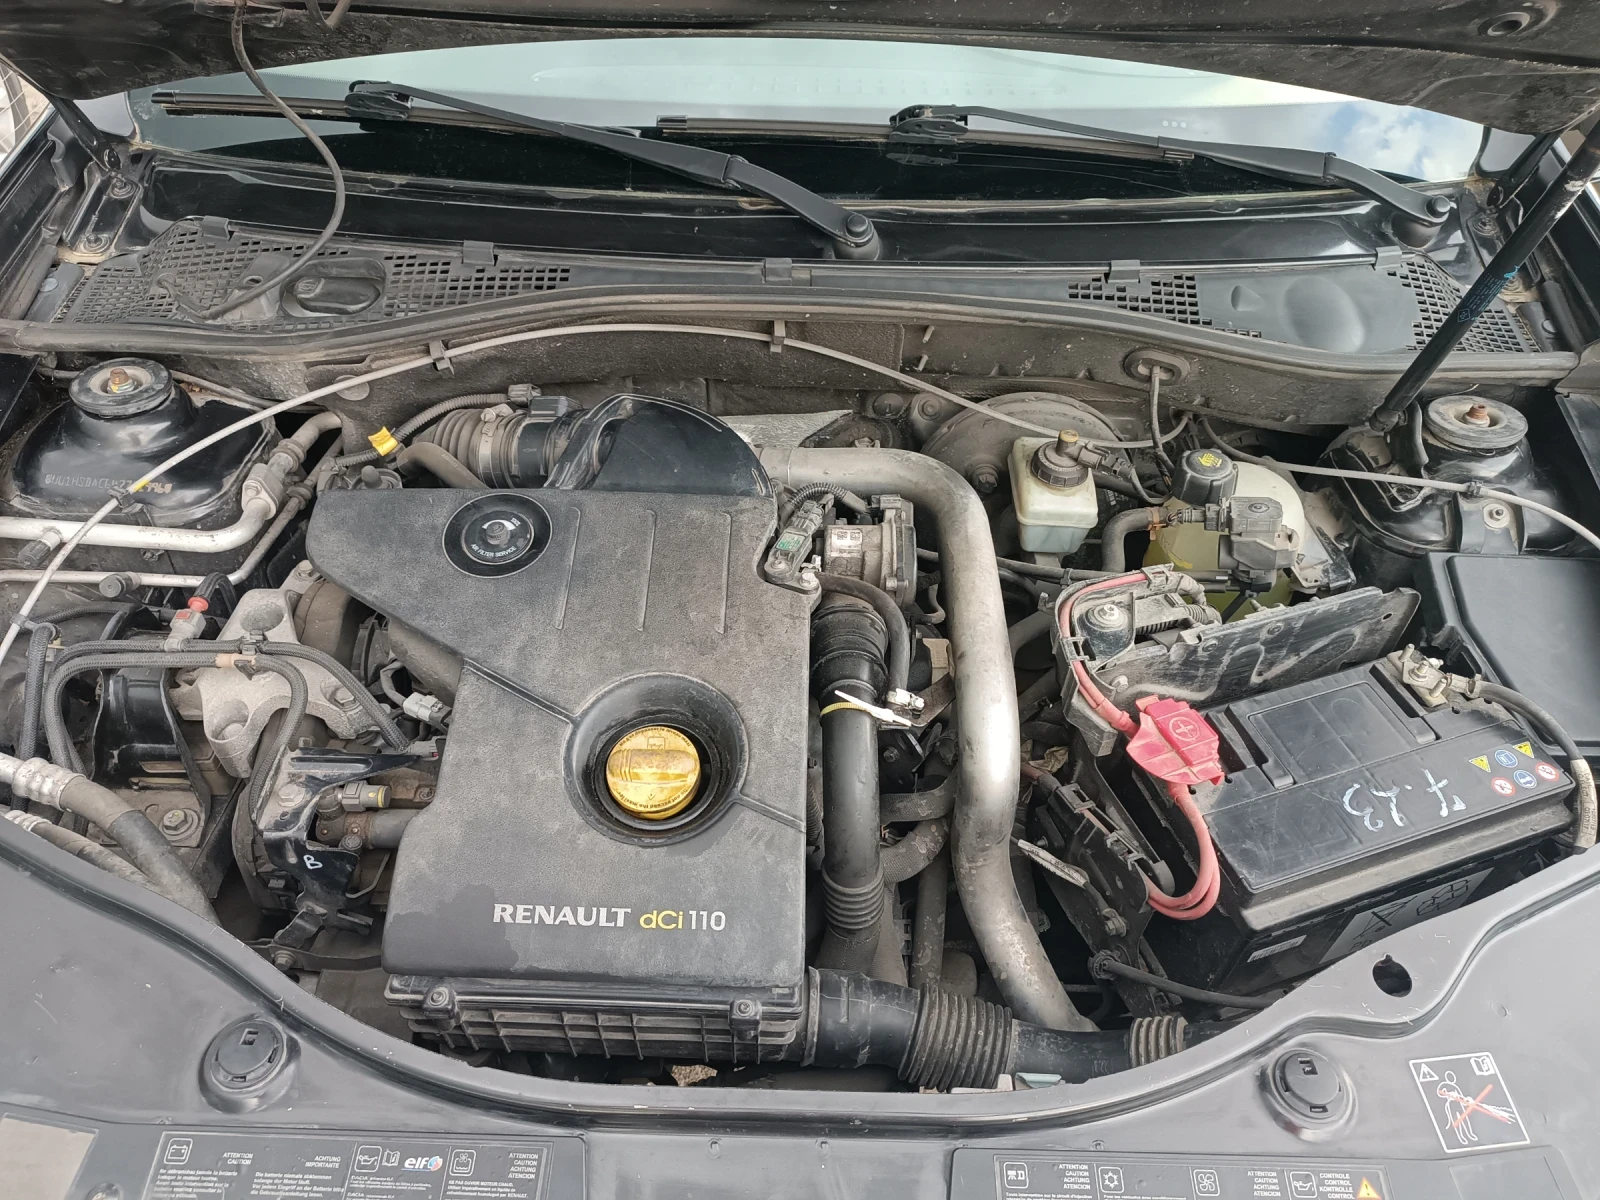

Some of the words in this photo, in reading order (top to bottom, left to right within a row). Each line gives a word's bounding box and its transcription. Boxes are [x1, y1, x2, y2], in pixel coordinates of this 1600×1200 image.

[494, 545, 517, 557] SERVICE
[493, 903, 631, 927] RENAULT
[639, 909, 684, 930] dCi
[689, 909, 726, 931] 110
[404, 1157, 429, 1169] elf
[1319, 1185, 1354, 1193] KONTROLLE
